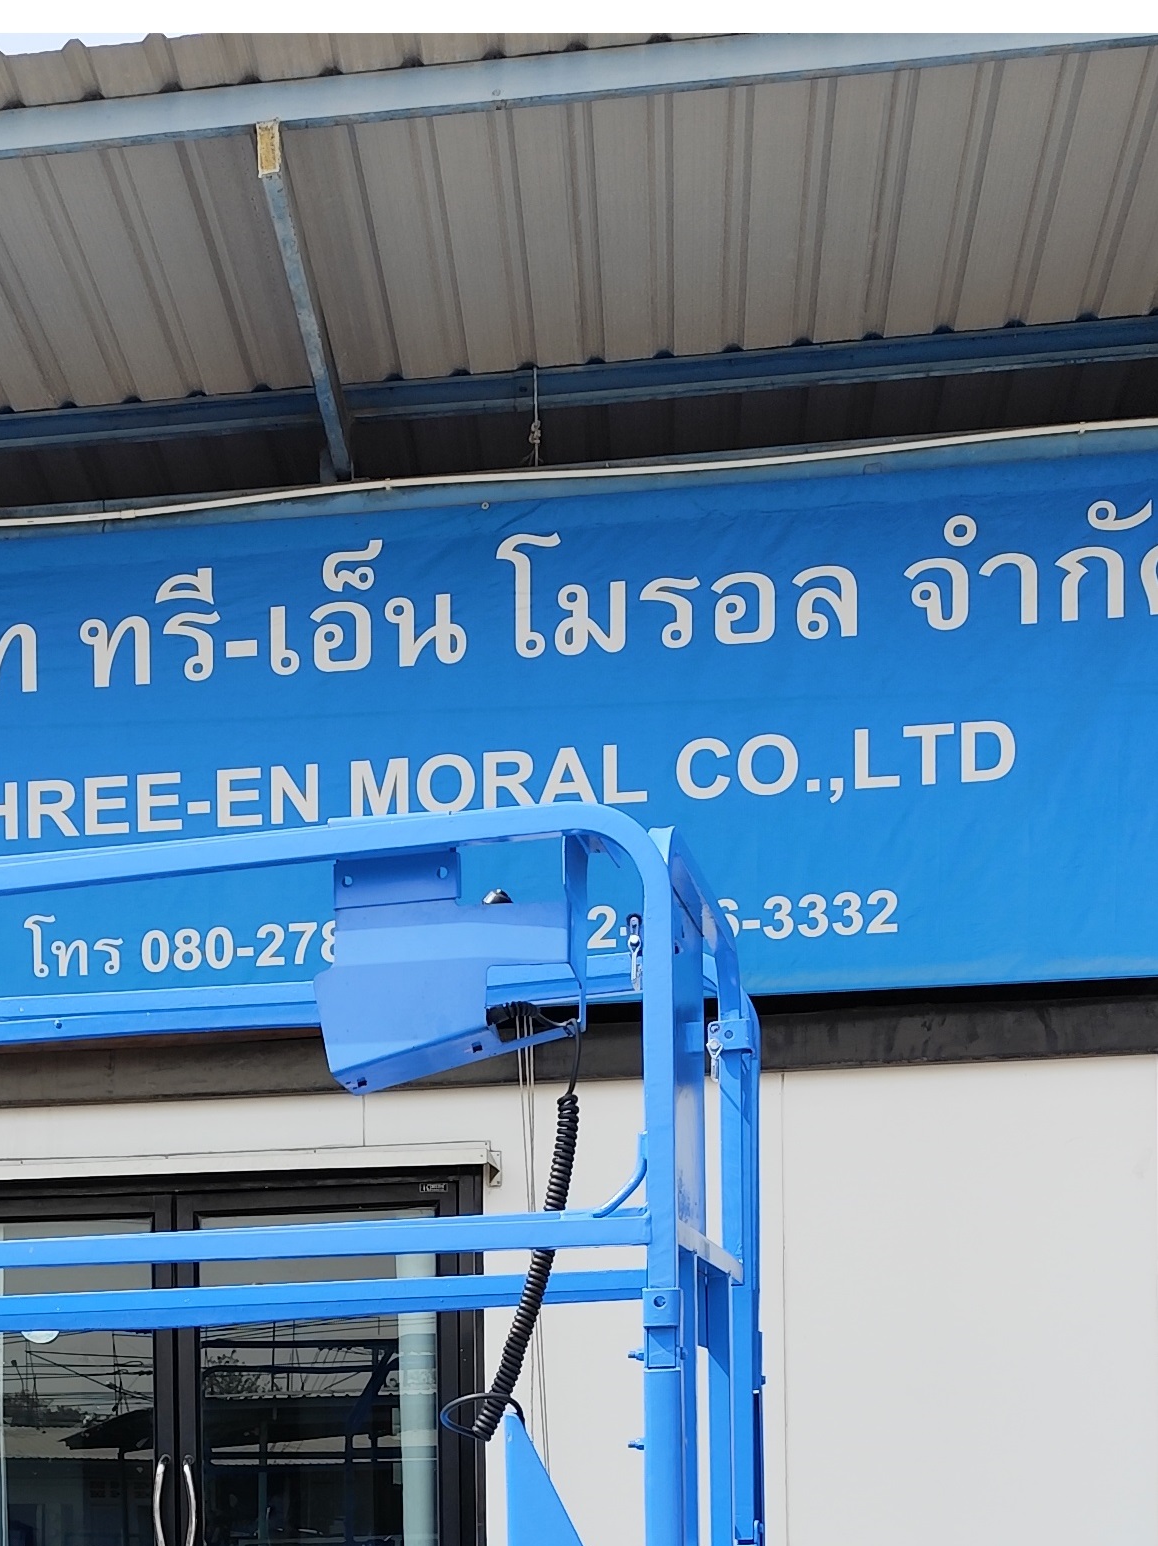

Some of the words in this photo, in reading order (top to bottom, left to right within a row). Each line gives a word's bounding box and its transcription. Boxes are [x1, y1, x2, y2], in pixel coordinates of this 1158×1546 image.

[80, 539, 467, 688] ทรี-เอ็น
[495, 532, 859, 659] โมรอล
[904, 499, 1158, 632] จำกั
[351, 745, 648, 818] MORAL
[675, 721, 1017, 804] CO.,LTD
[24, 915, 123, 977] โทร
